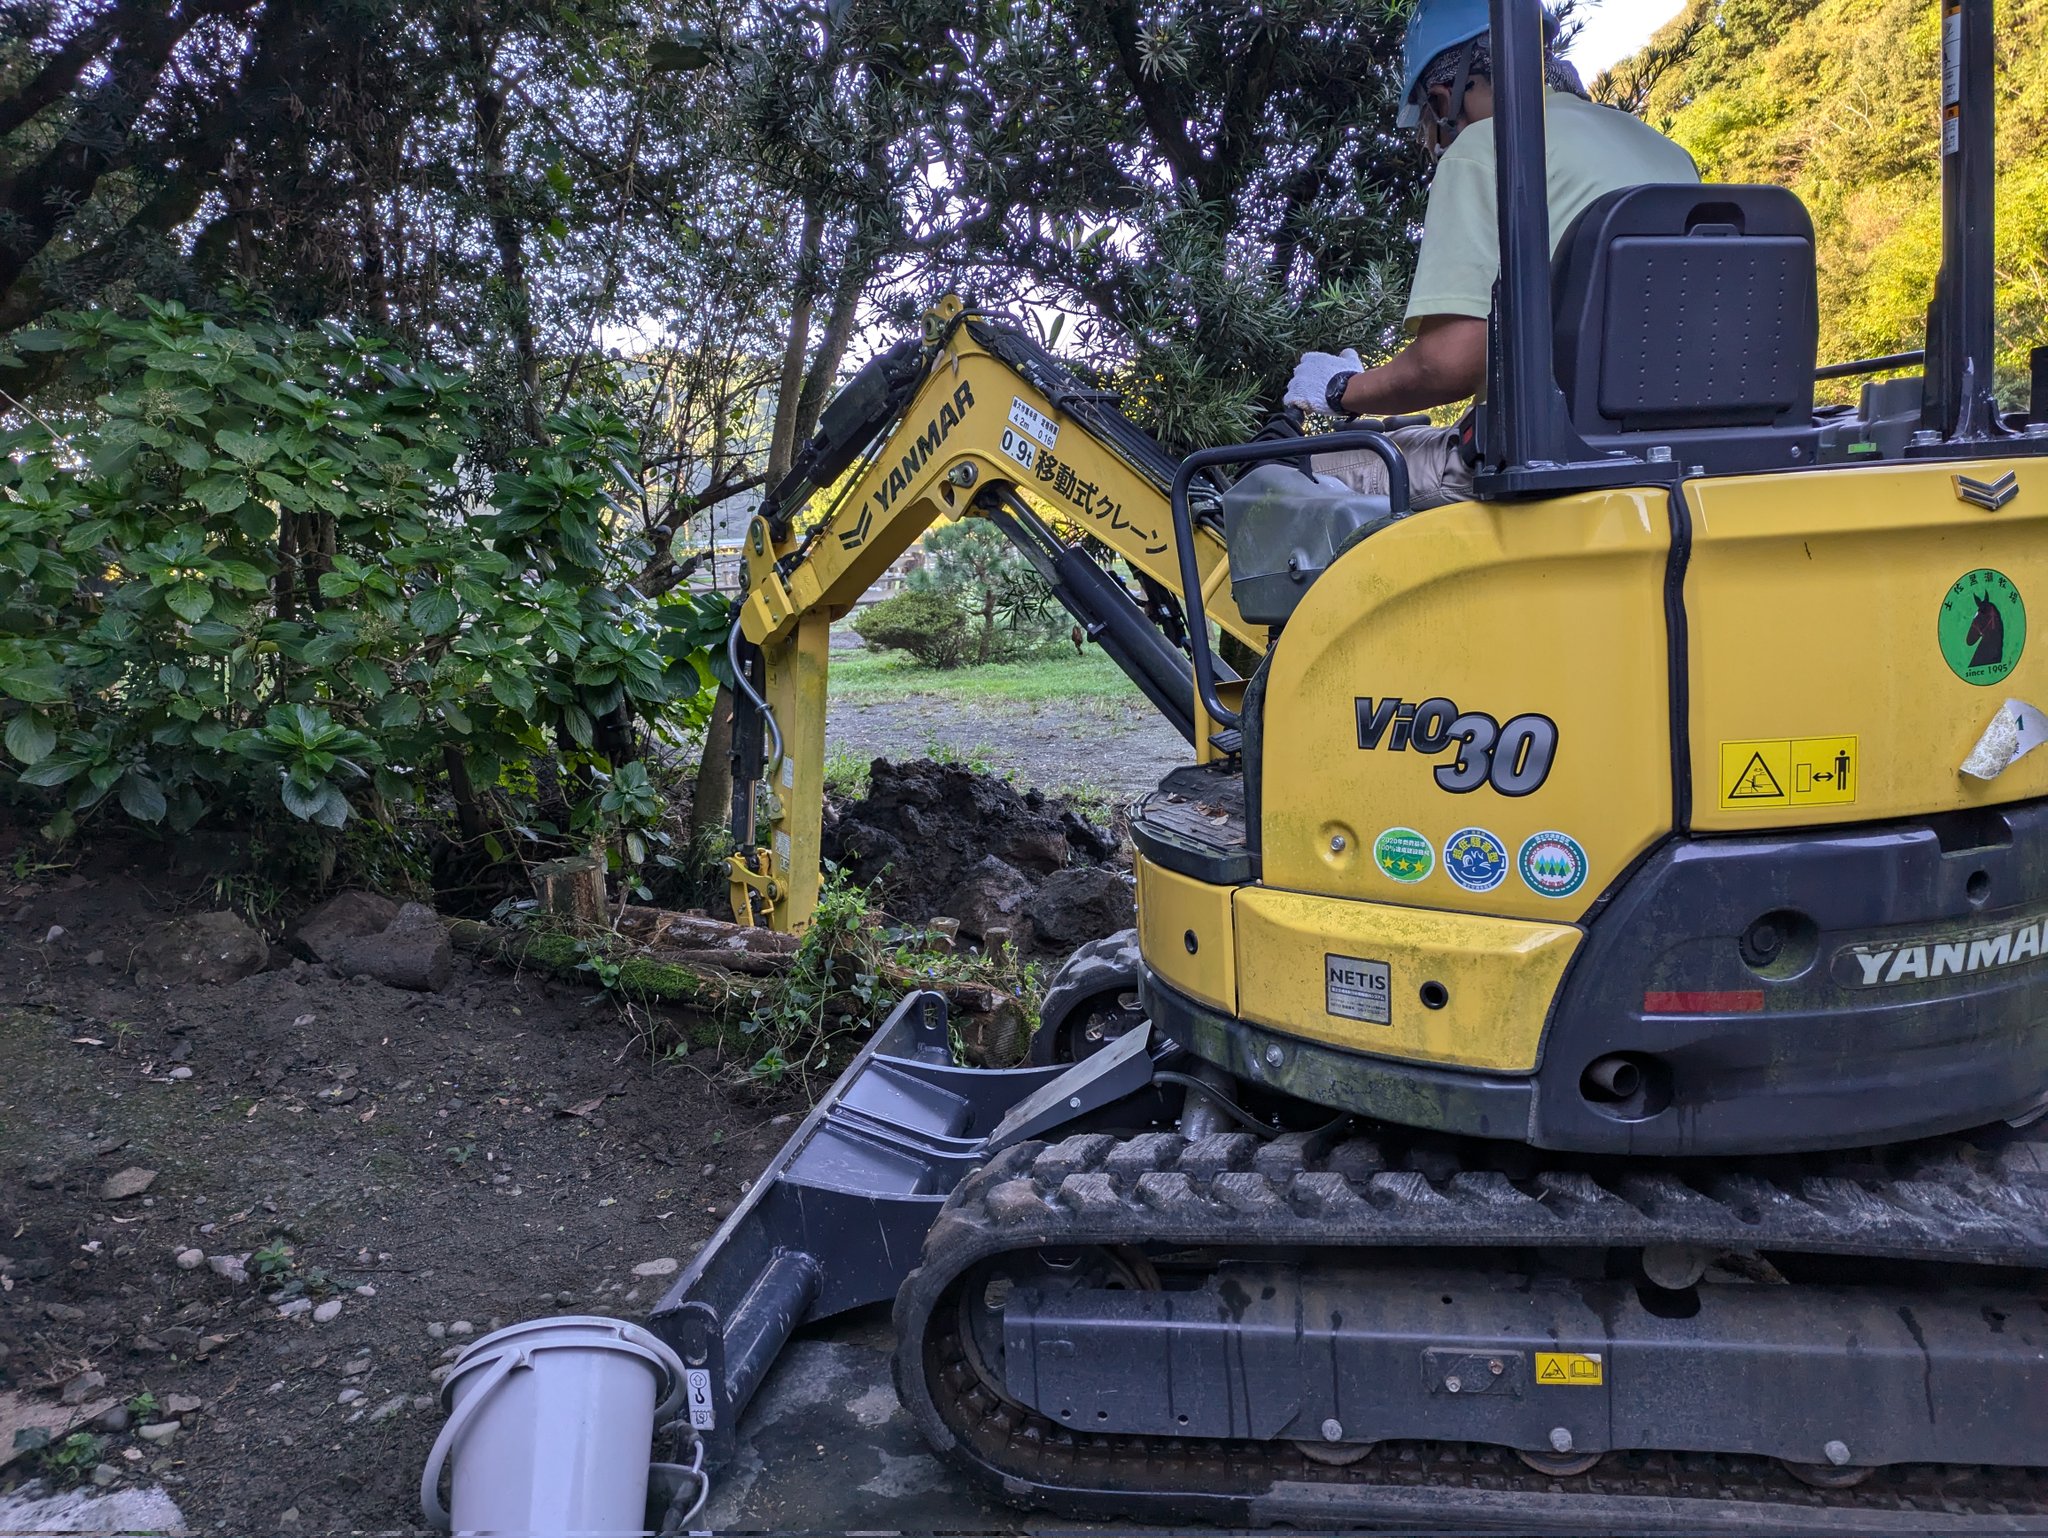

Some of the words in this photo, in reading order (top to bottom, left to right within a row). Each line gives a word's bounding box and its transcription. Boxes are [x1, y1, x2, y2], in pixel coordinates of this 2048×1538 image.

[873, 380, 975, 512] YANMAR
[1002, 430, 1032, 467] 0.9t
[1035, 449, 1167, 554] 移動式クレーン
[1965, 668, 1985, 677] since
[1987, 663, 2008, 674] 1995
[1452, 836, 1499, 863] 超低騒音型
[1853, 918, 2048, 985] YANMA
[1330, 967, 1386, 990] NETIS
